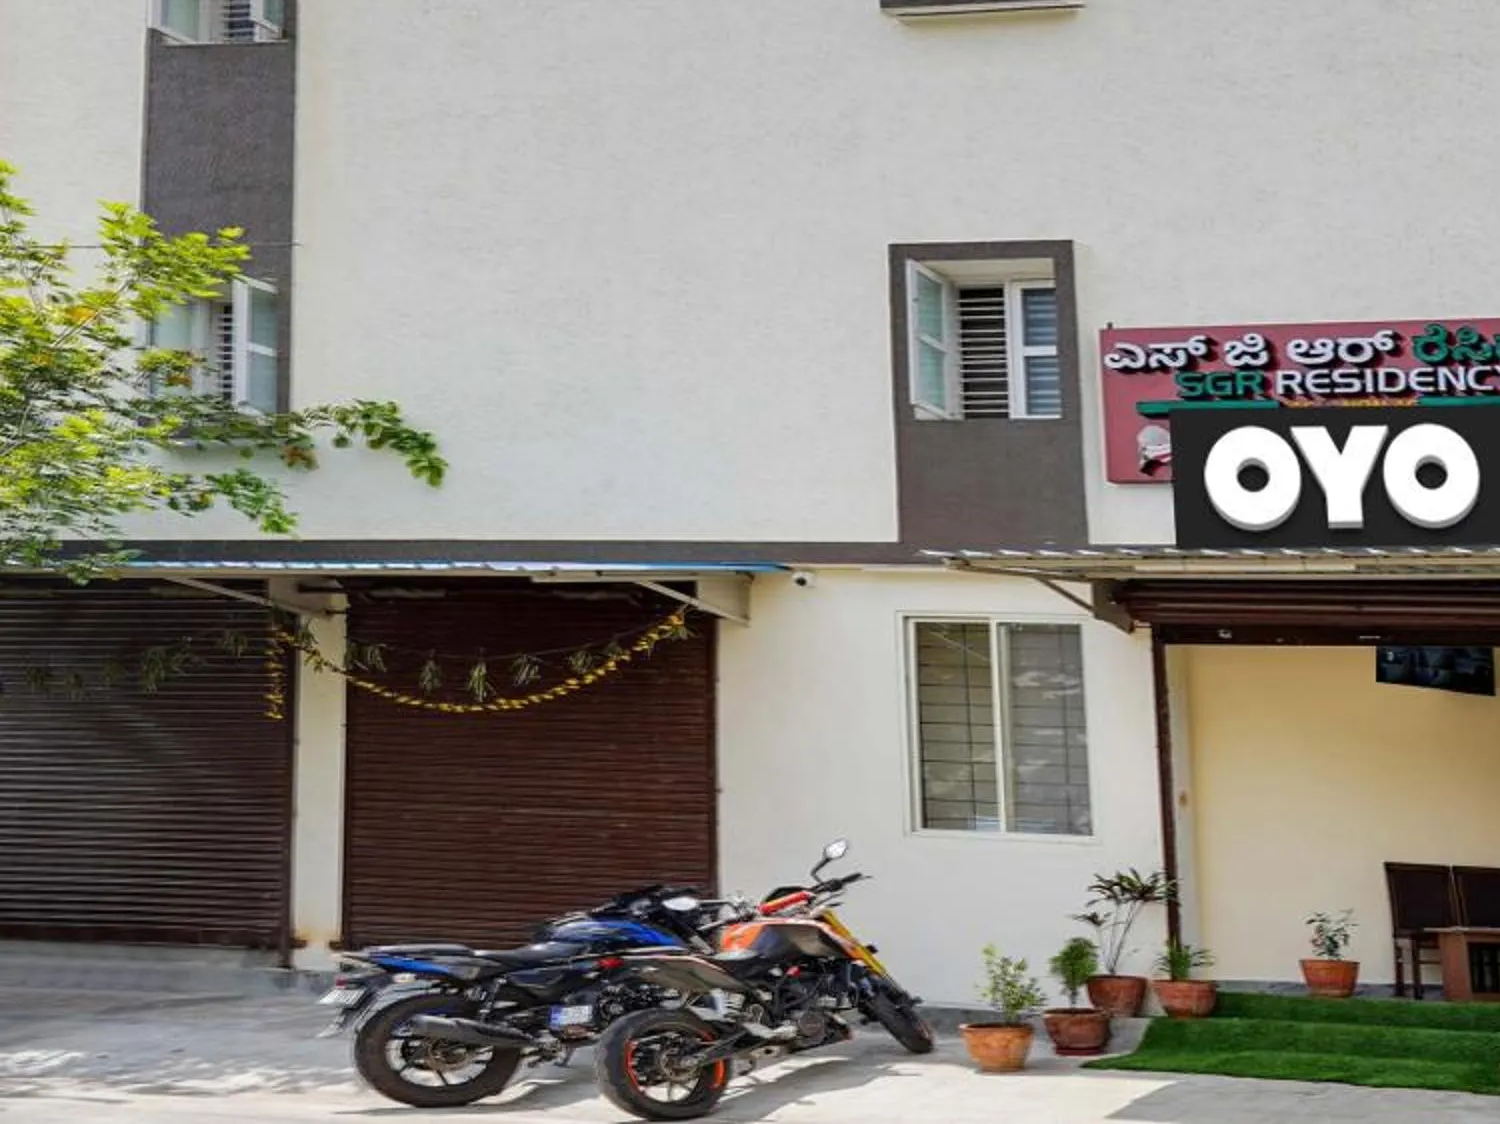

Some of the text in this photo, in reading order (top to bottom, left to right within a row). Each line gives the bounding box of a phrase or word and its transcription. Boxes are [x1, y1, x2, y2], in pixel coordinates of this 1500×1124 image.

[1287, 329, 1395, 364] ಆರ್
[1175, 371, 1264, 397] SGR
[1204, 423, 1480, 531] OYO
